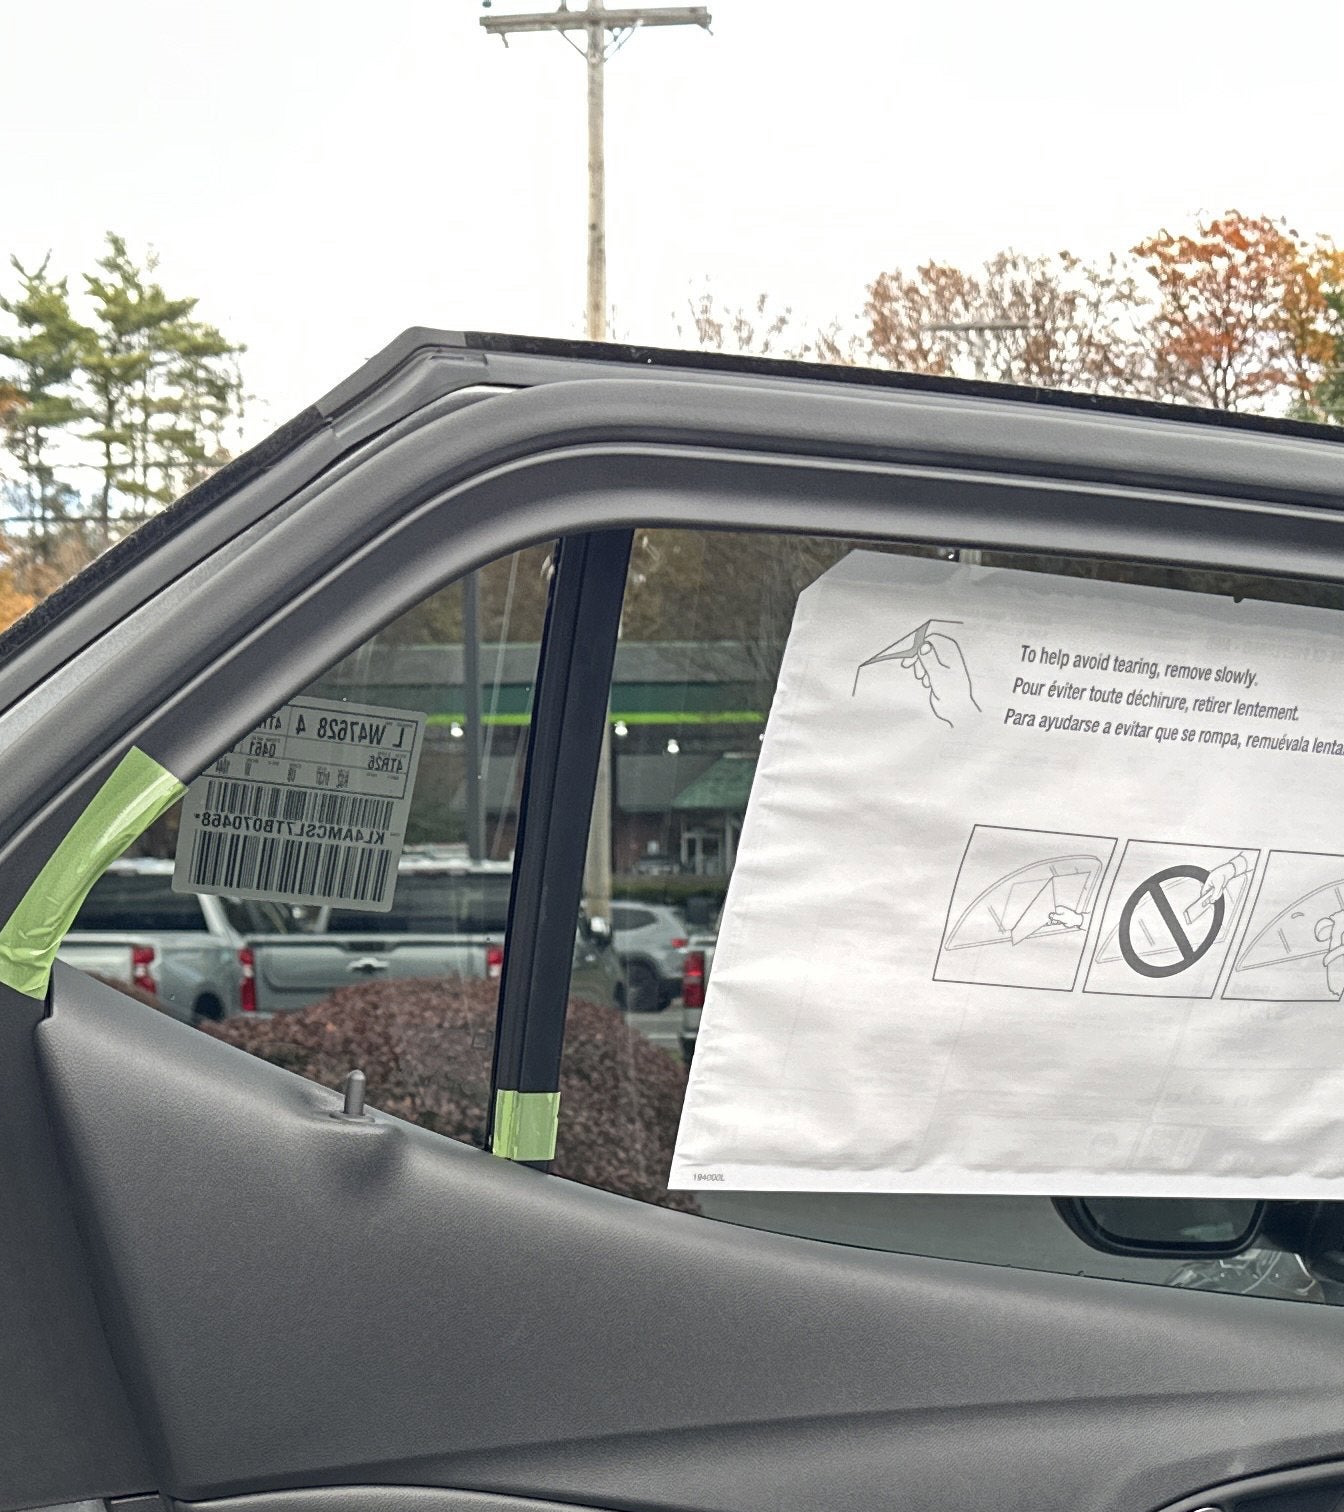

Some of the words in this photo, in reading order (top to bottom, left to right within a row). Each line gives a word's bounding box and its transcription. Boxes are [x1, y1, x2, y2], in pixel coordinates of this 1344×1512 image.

[1021, 644, 1036, 663] To
[1039, 646, 1070, 670] help
[1072, 652, 1111, 671] avoid
[1112, 655, 1160, 679] tearing,
[1164, 662, 1212, 682] remove
[1214, 665, 1259, 689] slowly.
[1012, 676, 1046, 696] Pour
[1047, 680, 1087, 701] éviter
[1089, 685, 1123, 705] toute
[1126, 688, 1189, 713] déchirure,
[1192, 695, 1232, 714] retirer
[1233, 698, 1299, 722] lentement.
[1003, 708, 1036, 727] Para
[1038, 714, 1100, 733] ayudarse
[1102, 721, 1112, 735] a
[1114, 720, 1154, 739] evitar
[1155, 725, 1179, 744] que
[1180, 728, 1196, 743] se
[1197, 729, 1242, 750] rompa,
[1245, 733, 1310, 753] remuévala
